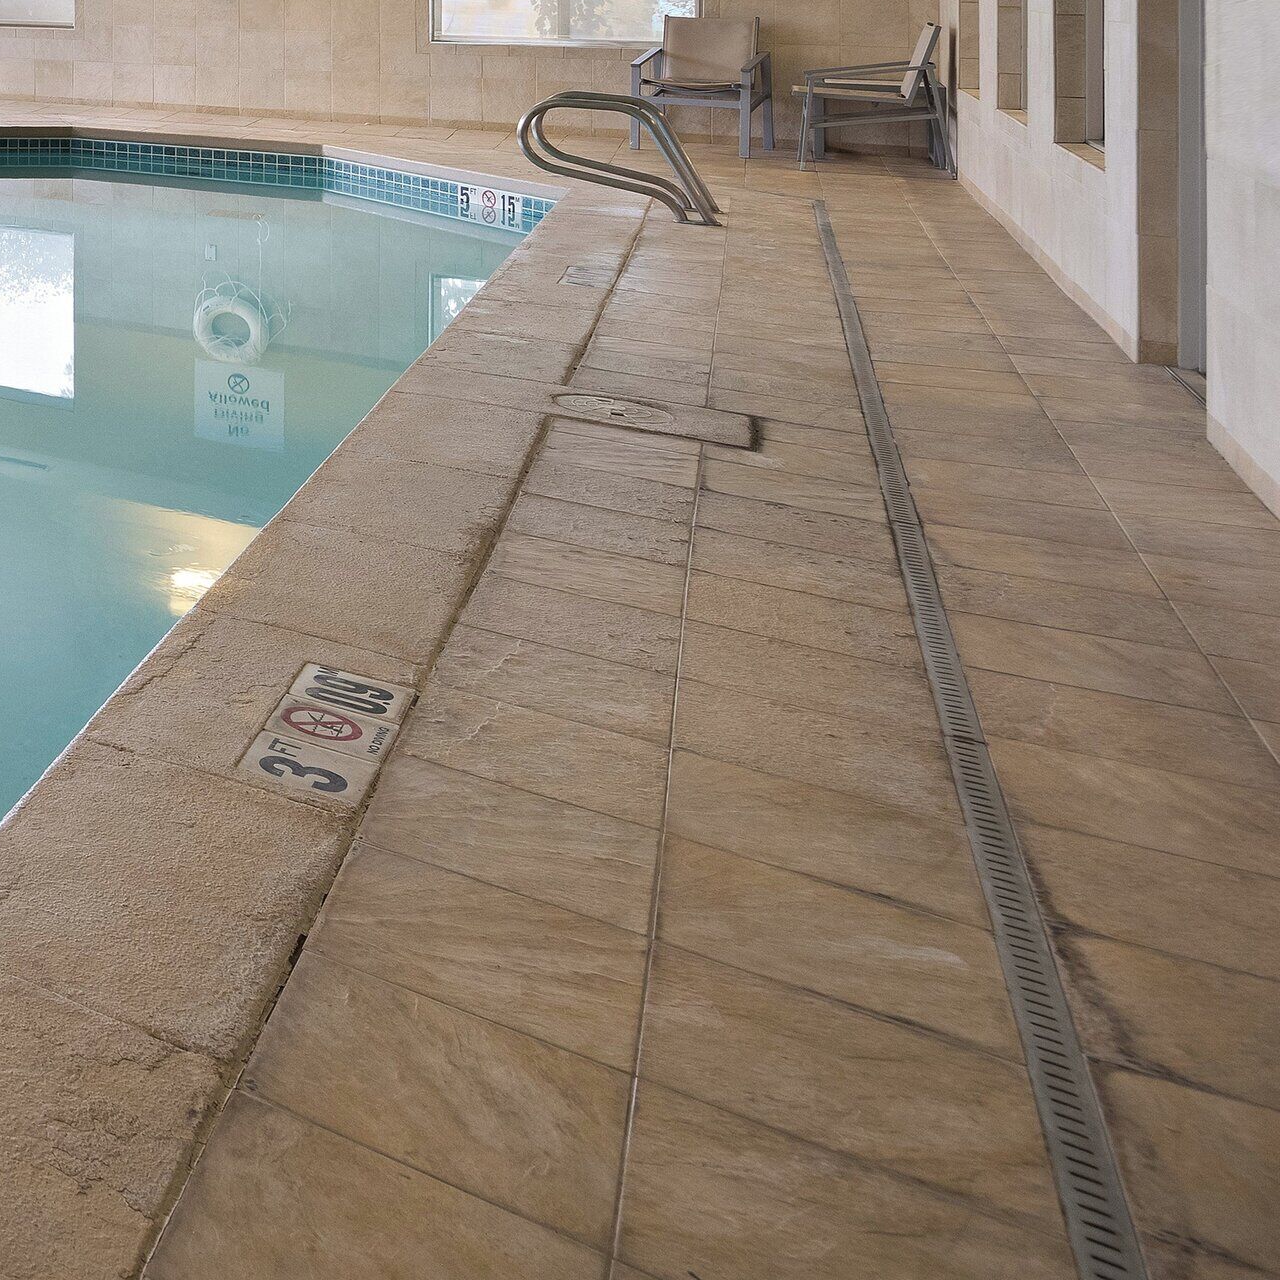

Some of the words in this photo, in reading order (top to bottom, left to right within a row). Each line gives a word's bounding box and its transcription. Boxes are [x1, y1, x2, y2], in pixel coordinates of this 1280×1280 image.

[460, 186, 470, 205] 5
[371, 726, 390, 746] DIVING
[268, 737, 302, 758] FT
[366, 744, 381, 756] NO
[259, 755, 349, 793] 3
